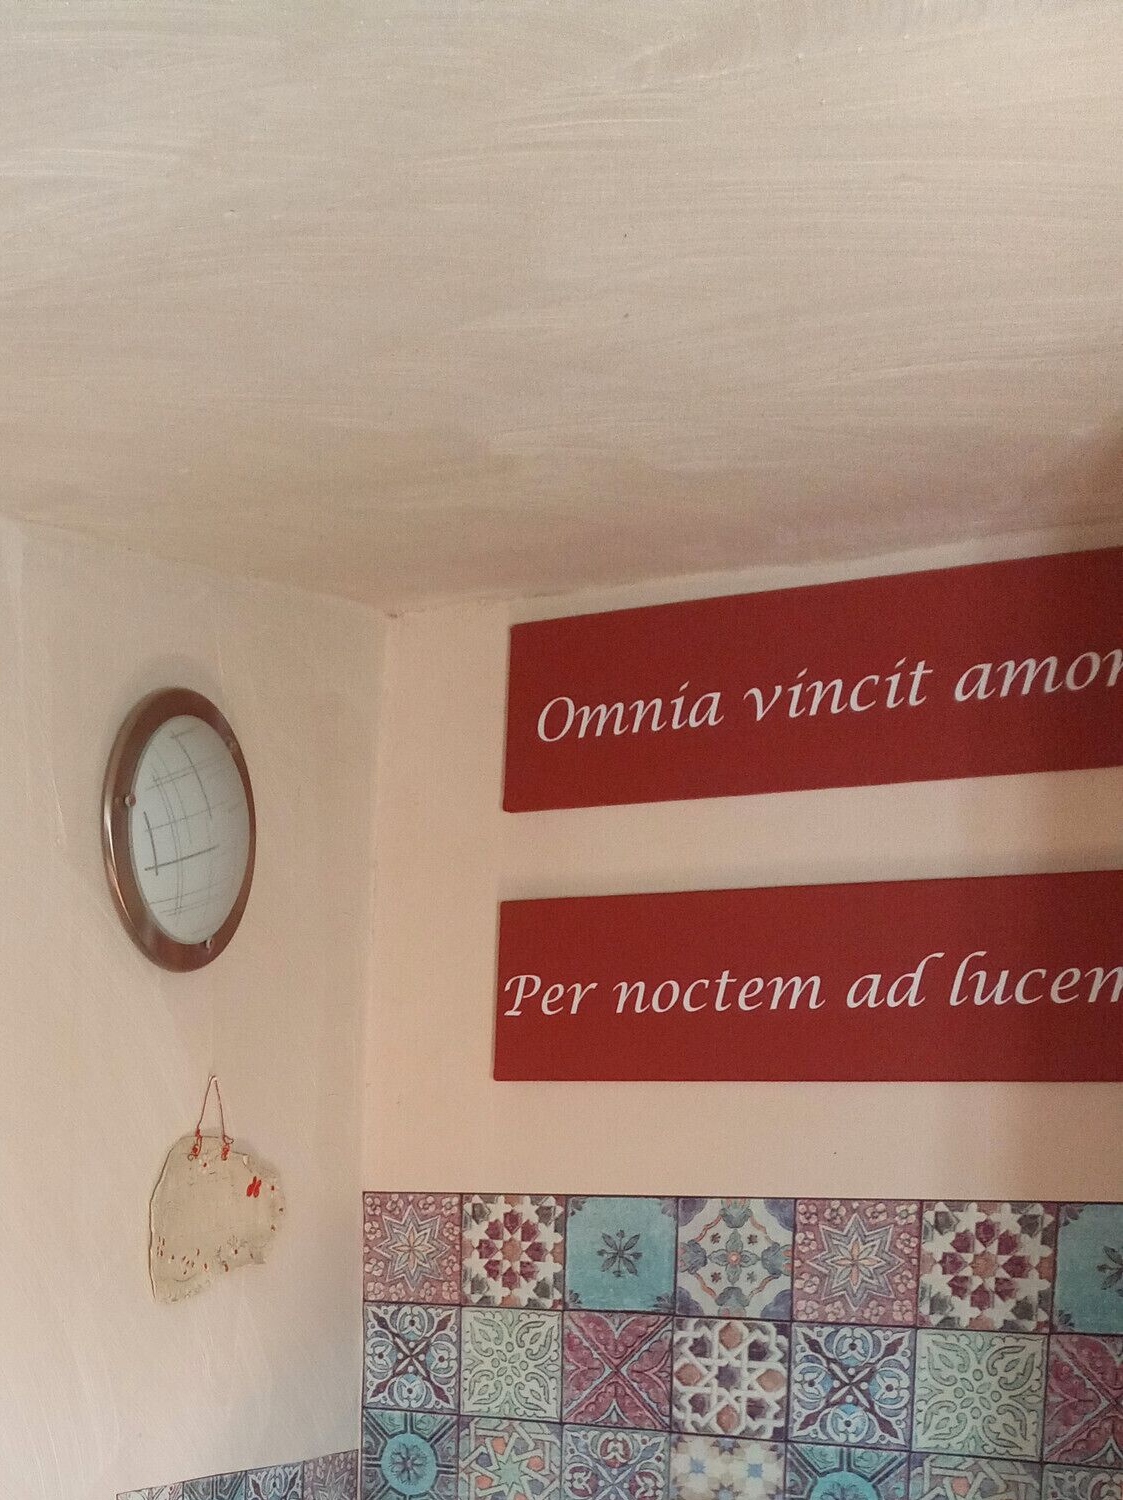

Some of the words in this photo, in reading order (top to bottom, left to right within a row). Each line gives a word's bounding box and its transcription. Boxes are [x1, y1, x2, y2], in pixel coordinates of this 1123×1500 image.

[536, 680, 726, 743] Omnia
[743, 655, 934, 722] vincit
[953, 649, 1123, 703] amor
[503, 973, 599, 1017] Per
[612, 969, 826, 1014] noctem
[846, 952, 946, 1010] ad
